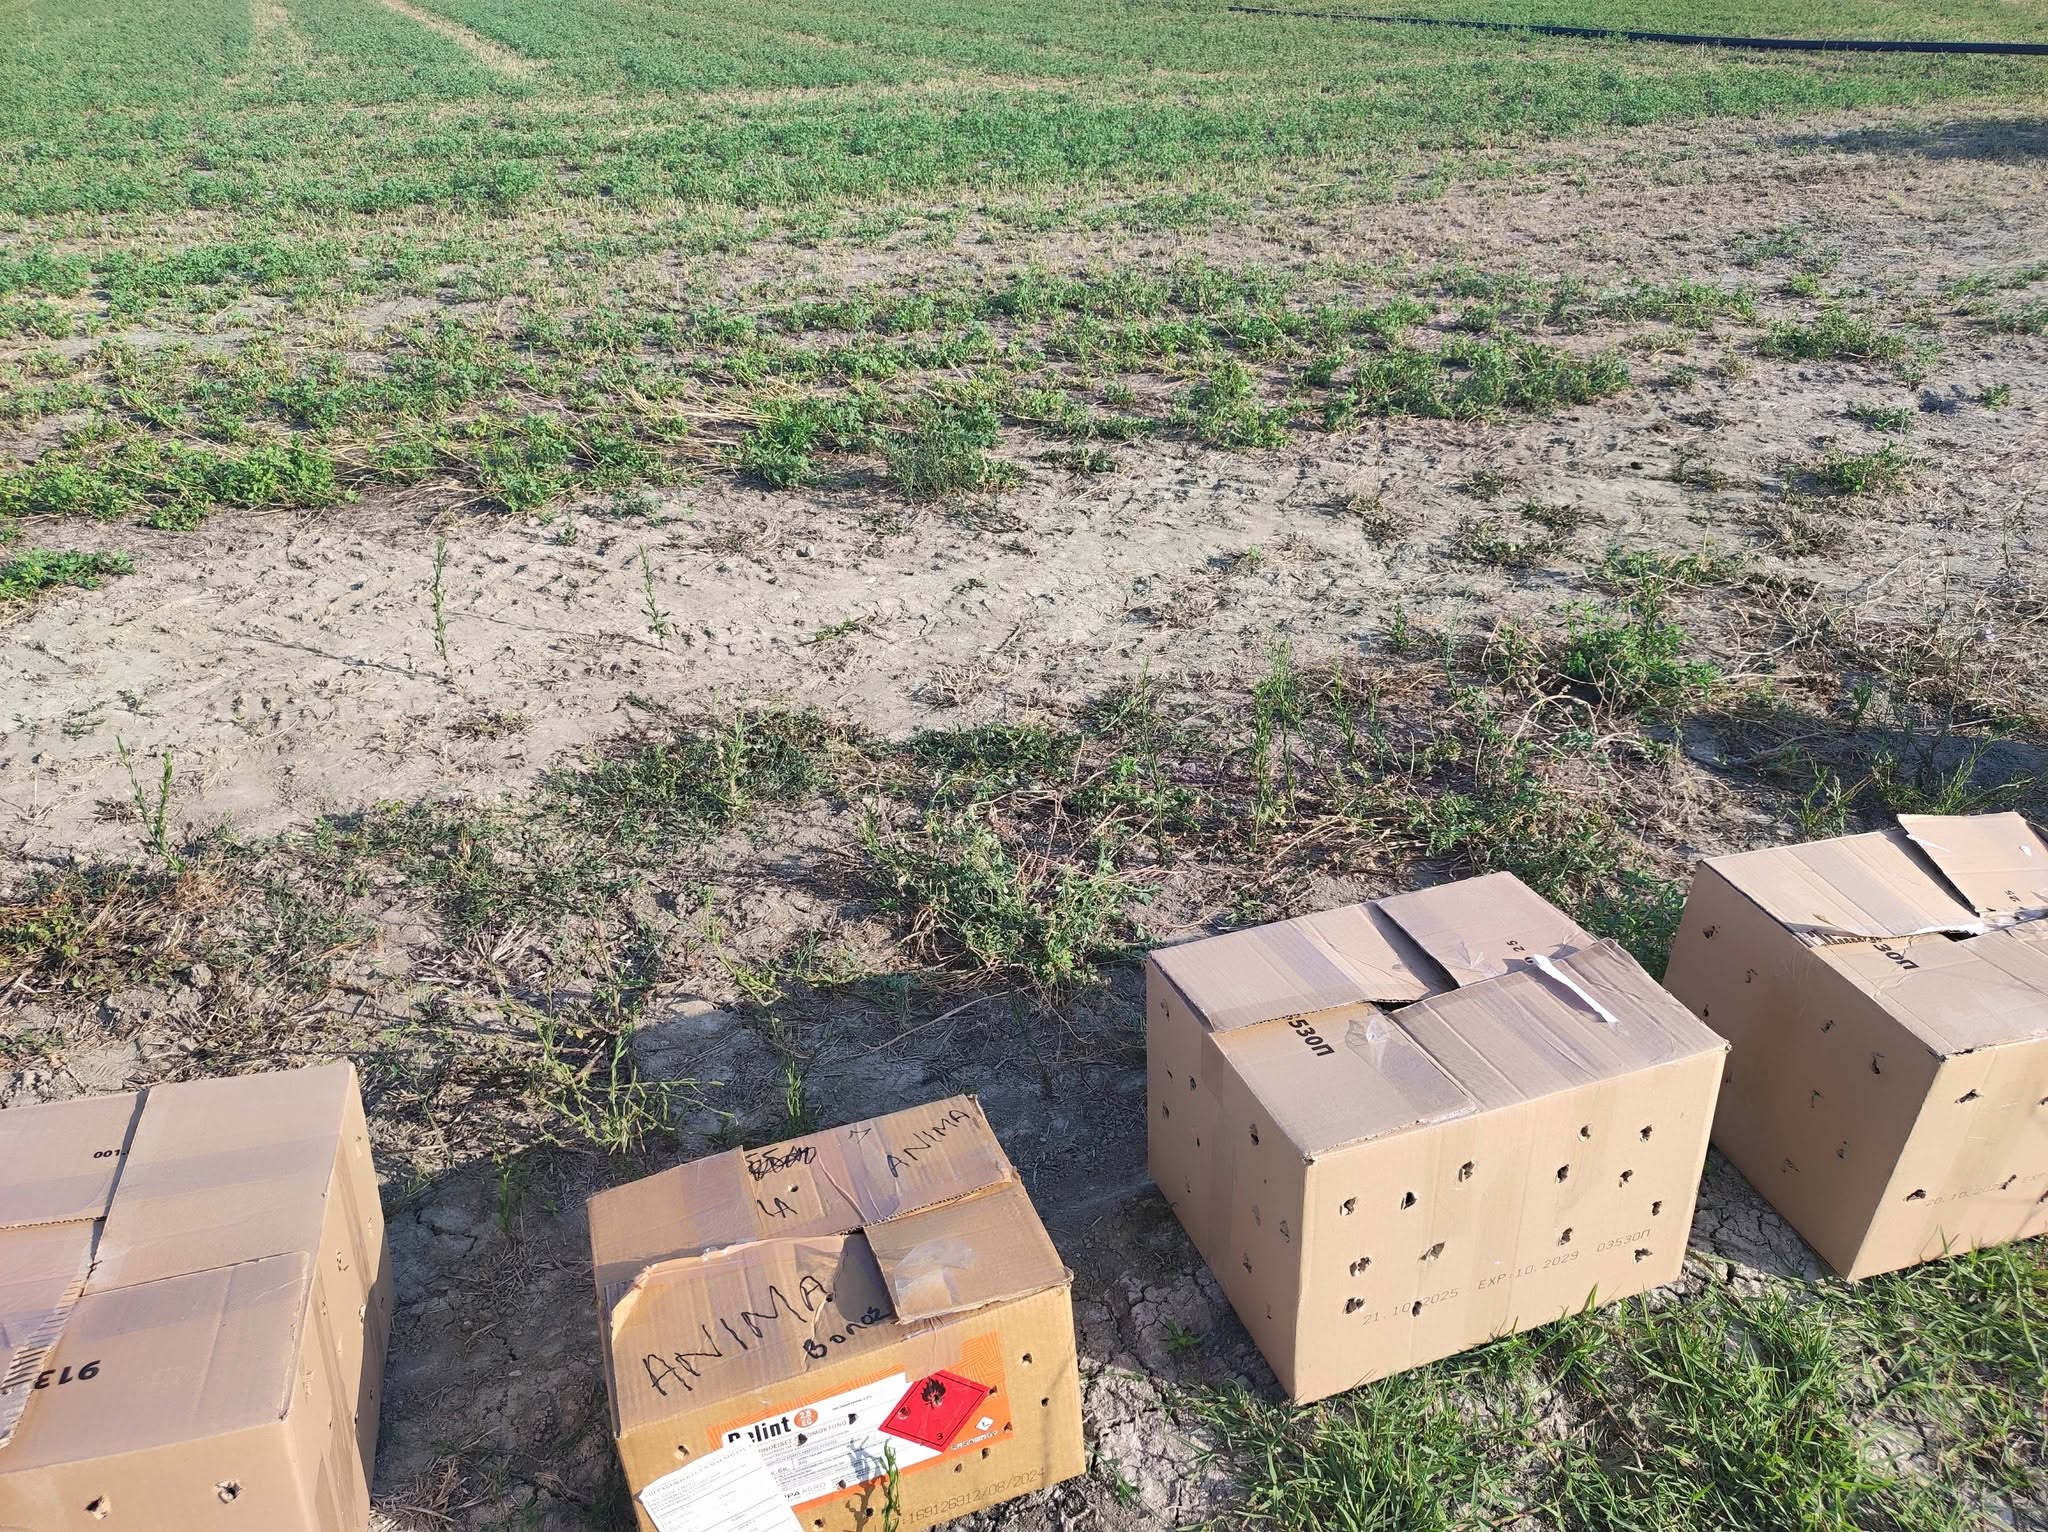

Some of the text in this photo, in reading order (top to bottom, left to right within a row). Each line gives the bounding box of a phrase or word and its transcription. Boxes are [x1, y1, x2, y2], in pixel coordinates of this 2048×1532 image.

[886, 1108, 971, 1178] ANIMA
[642, 1275, 831, 1396] ANIMA
[936, 1432, 944, 1441] 3
